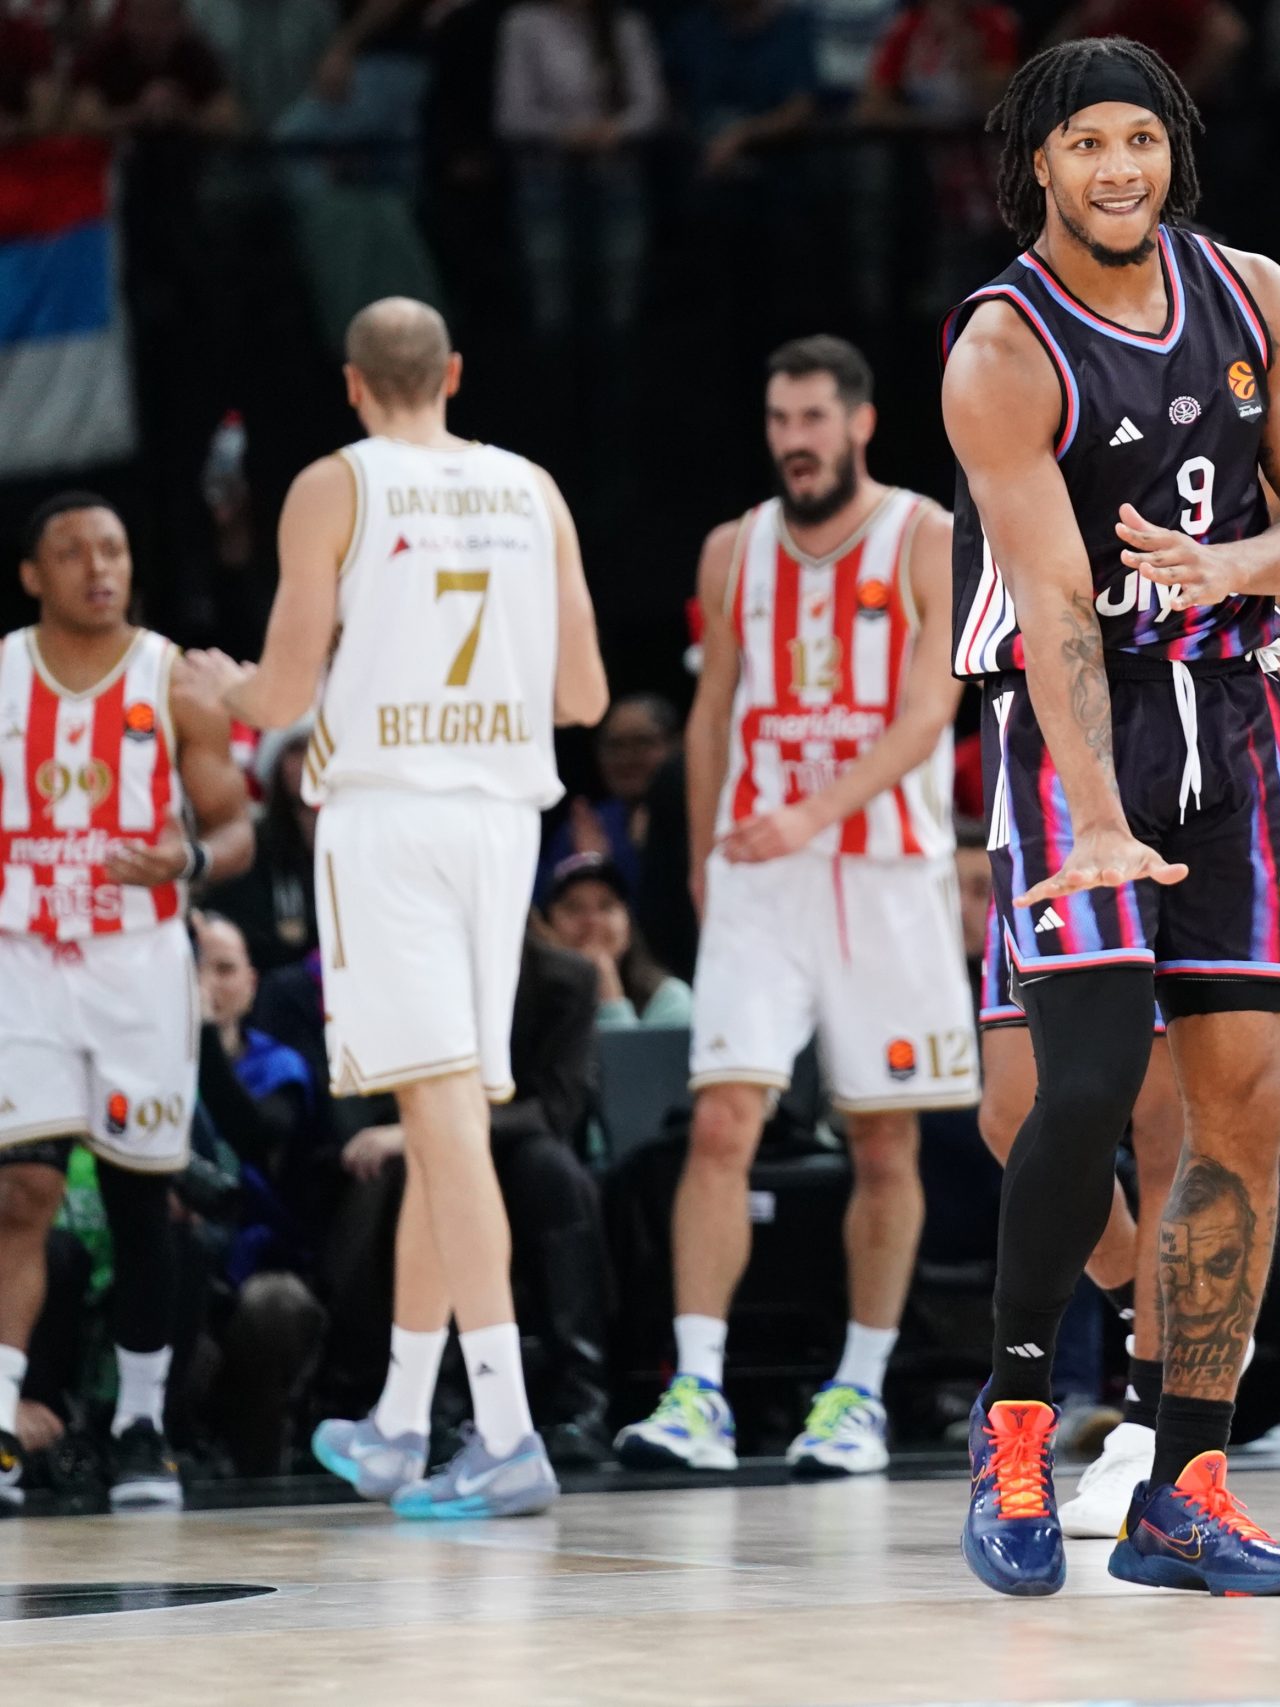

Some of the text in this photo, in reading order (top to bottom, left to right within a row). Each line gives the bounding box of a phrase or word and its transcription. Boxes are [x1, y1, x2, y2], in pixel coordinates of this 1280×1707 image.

[1176, 455, 1216, 536] 9
[434, 569, 490, 687] 7
[786, 635, 845, 694] 12
[34, 758, 113, 820] 99
[30, 877, 123, 921] mts
[926, 1031, 973, 1079] 12
